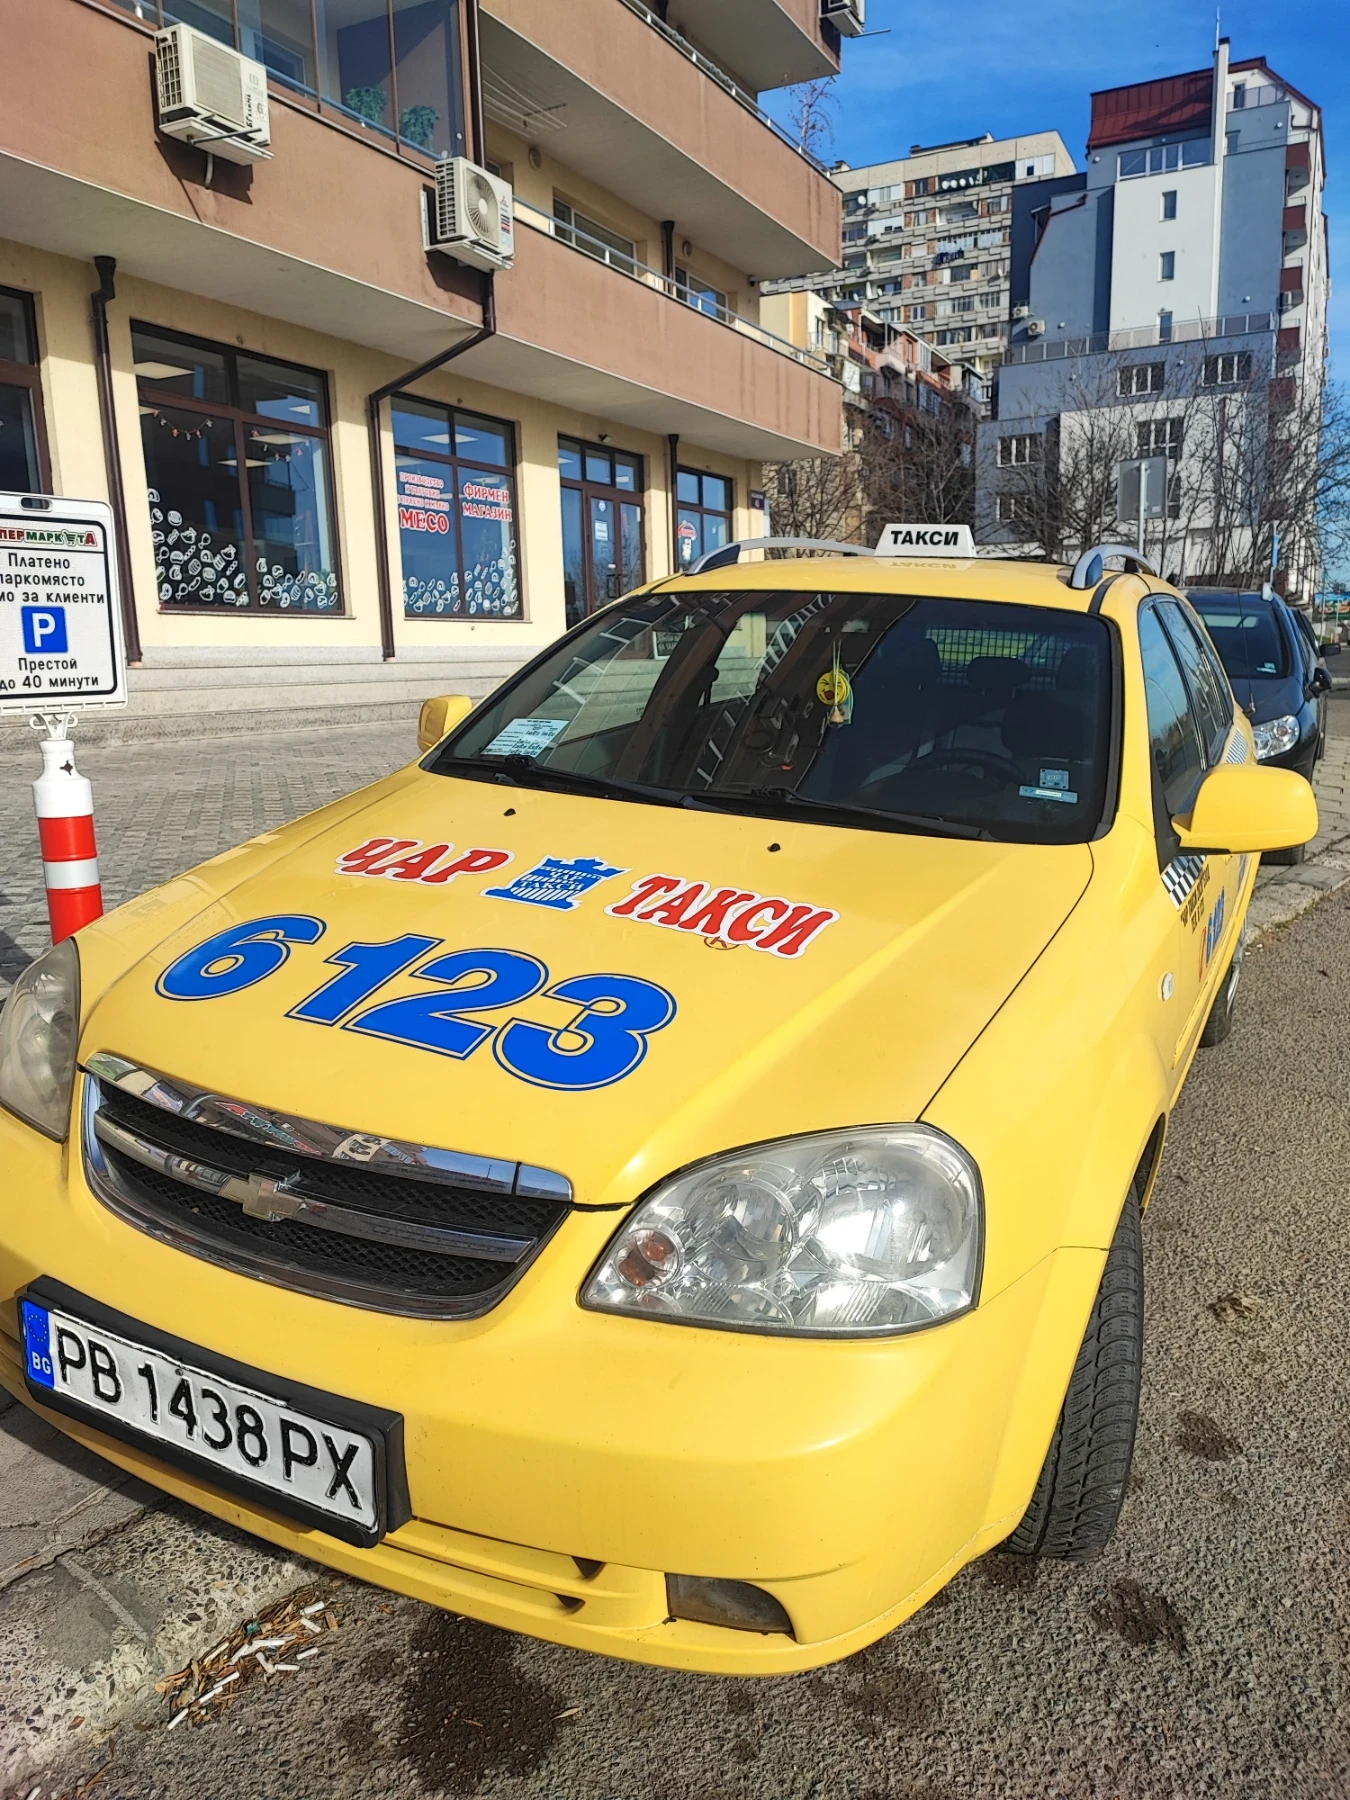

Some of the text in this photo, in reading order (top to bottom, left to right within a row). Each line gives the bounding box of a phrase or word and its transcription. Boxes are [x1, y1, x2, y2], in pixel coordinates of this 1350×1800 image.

[463, 502, 511, 521] МАГАЗИН
[400, 508, 448, 533] МЕСО
[890, 530, 959, 546] ТАКСИ
[8, 552, 70, 569] Платено
[22, 592, 39, 602] за
[46, 592, 104, 604] клиенти
[18, 657, 78, 673] Престой
[0, 675, 99, 692] до 40 минути
[520, 881, 585, 891] ТАКСИ
[611, 875, 834, 956] ТАКСИ
[31, 1351, 53, 1375] BG
[138, 1361, 269, 1467] 1438
